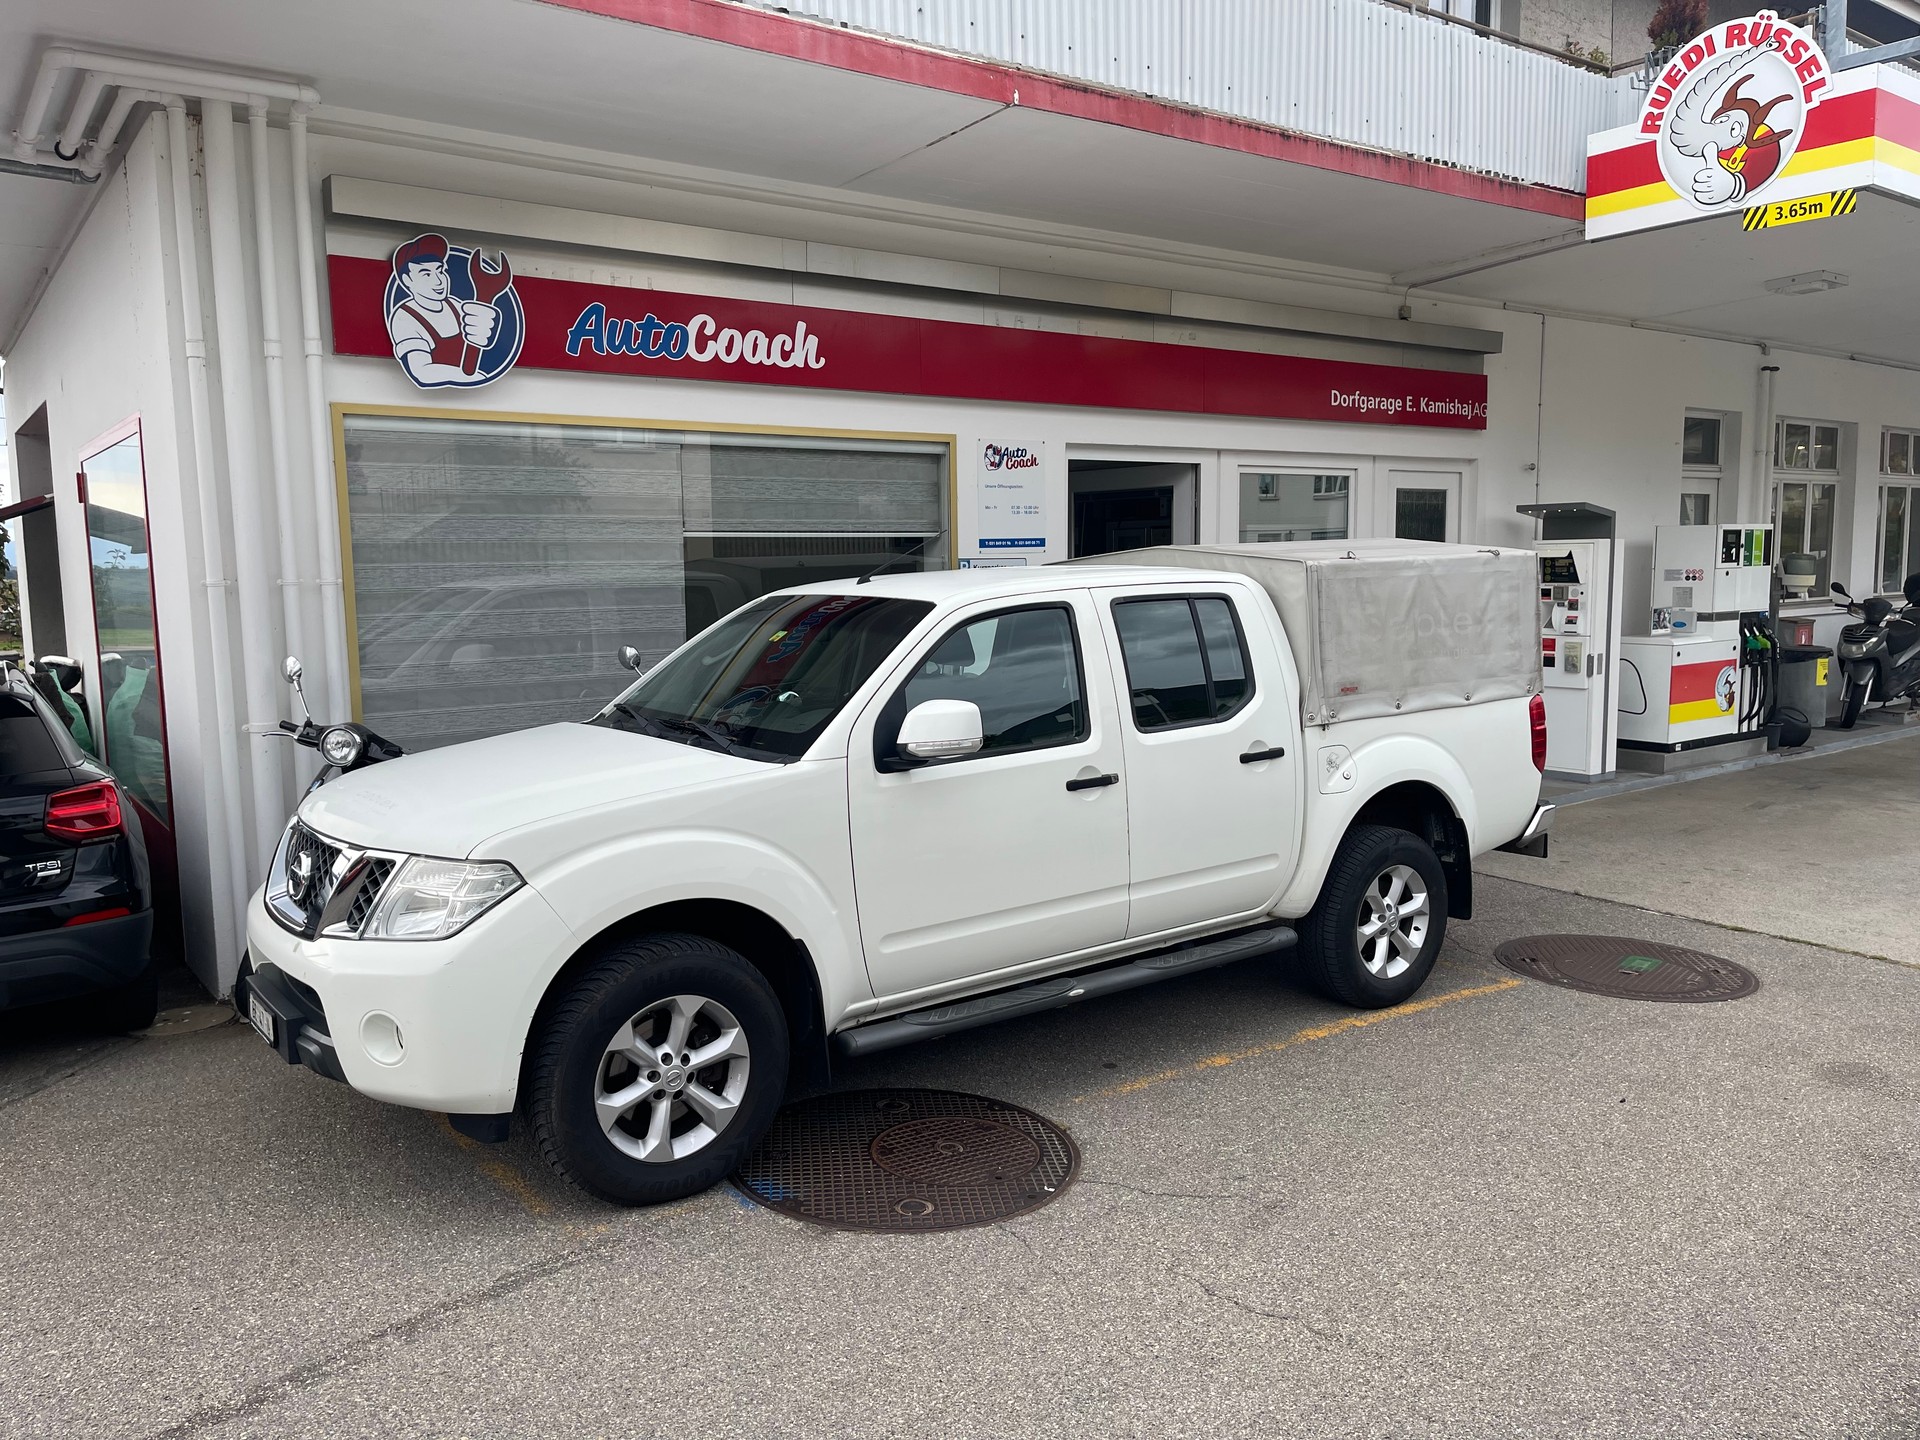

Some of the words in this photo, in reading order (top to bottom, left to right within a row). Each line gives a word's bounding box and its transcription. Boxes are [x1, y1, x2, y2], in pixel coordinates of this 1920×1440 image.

[1640, 34, 1717, 134] RUEDI
[1724, 13, 1828, 105] RÜSSEL
[1774, 202, 1823, 221] 3.65m
[1331, 390, 1402, 414] Dorfgarage
[1406, 396, 1416, 411] E.
[1420, 397, 1472, 419] Kamishaj
[1002, 447, 1027, 460] Auto
[1006, 454, 1039, 470] Coach
[1730, 547, 1736, 561] 1
[25, 860, 61, 871] TFSI
